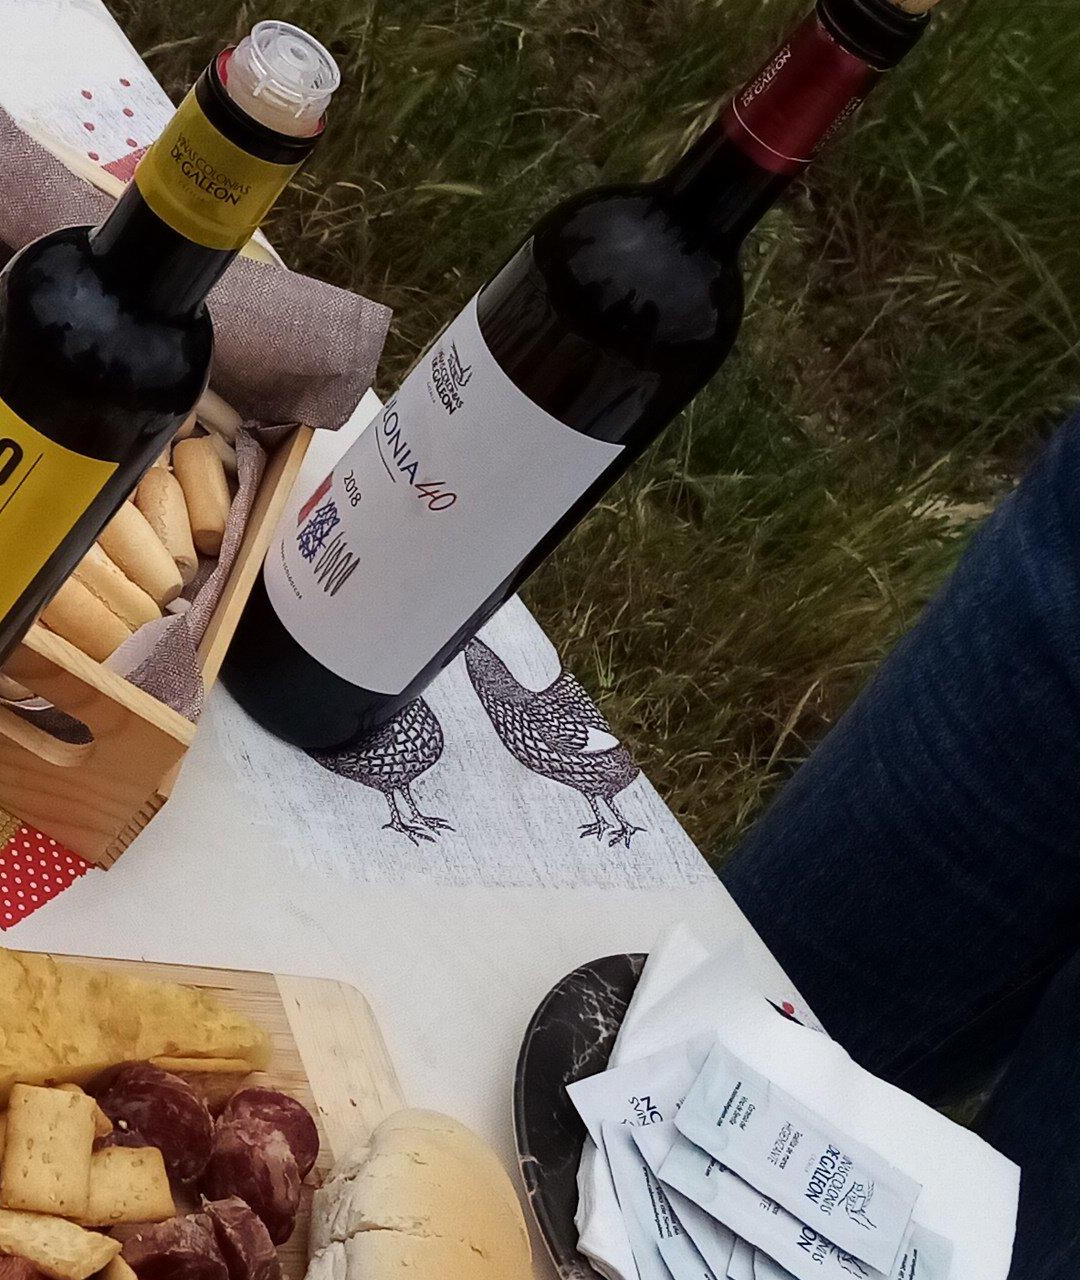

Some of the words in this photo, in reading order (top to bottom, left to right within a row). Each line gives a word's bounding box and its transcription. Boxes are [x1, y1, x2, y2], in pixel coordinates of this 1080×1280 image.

[170, 144, 183, 162] DE
[181, 161, 241, 206] GALEON
[196, 156, 252, 195] COLONIAS
[432, 368, 456, 415] GALEON
[383, 400, 419, 485] LONIA
[415, 481, 457, 511] 40
[343, 469, 361, 507] 2018
